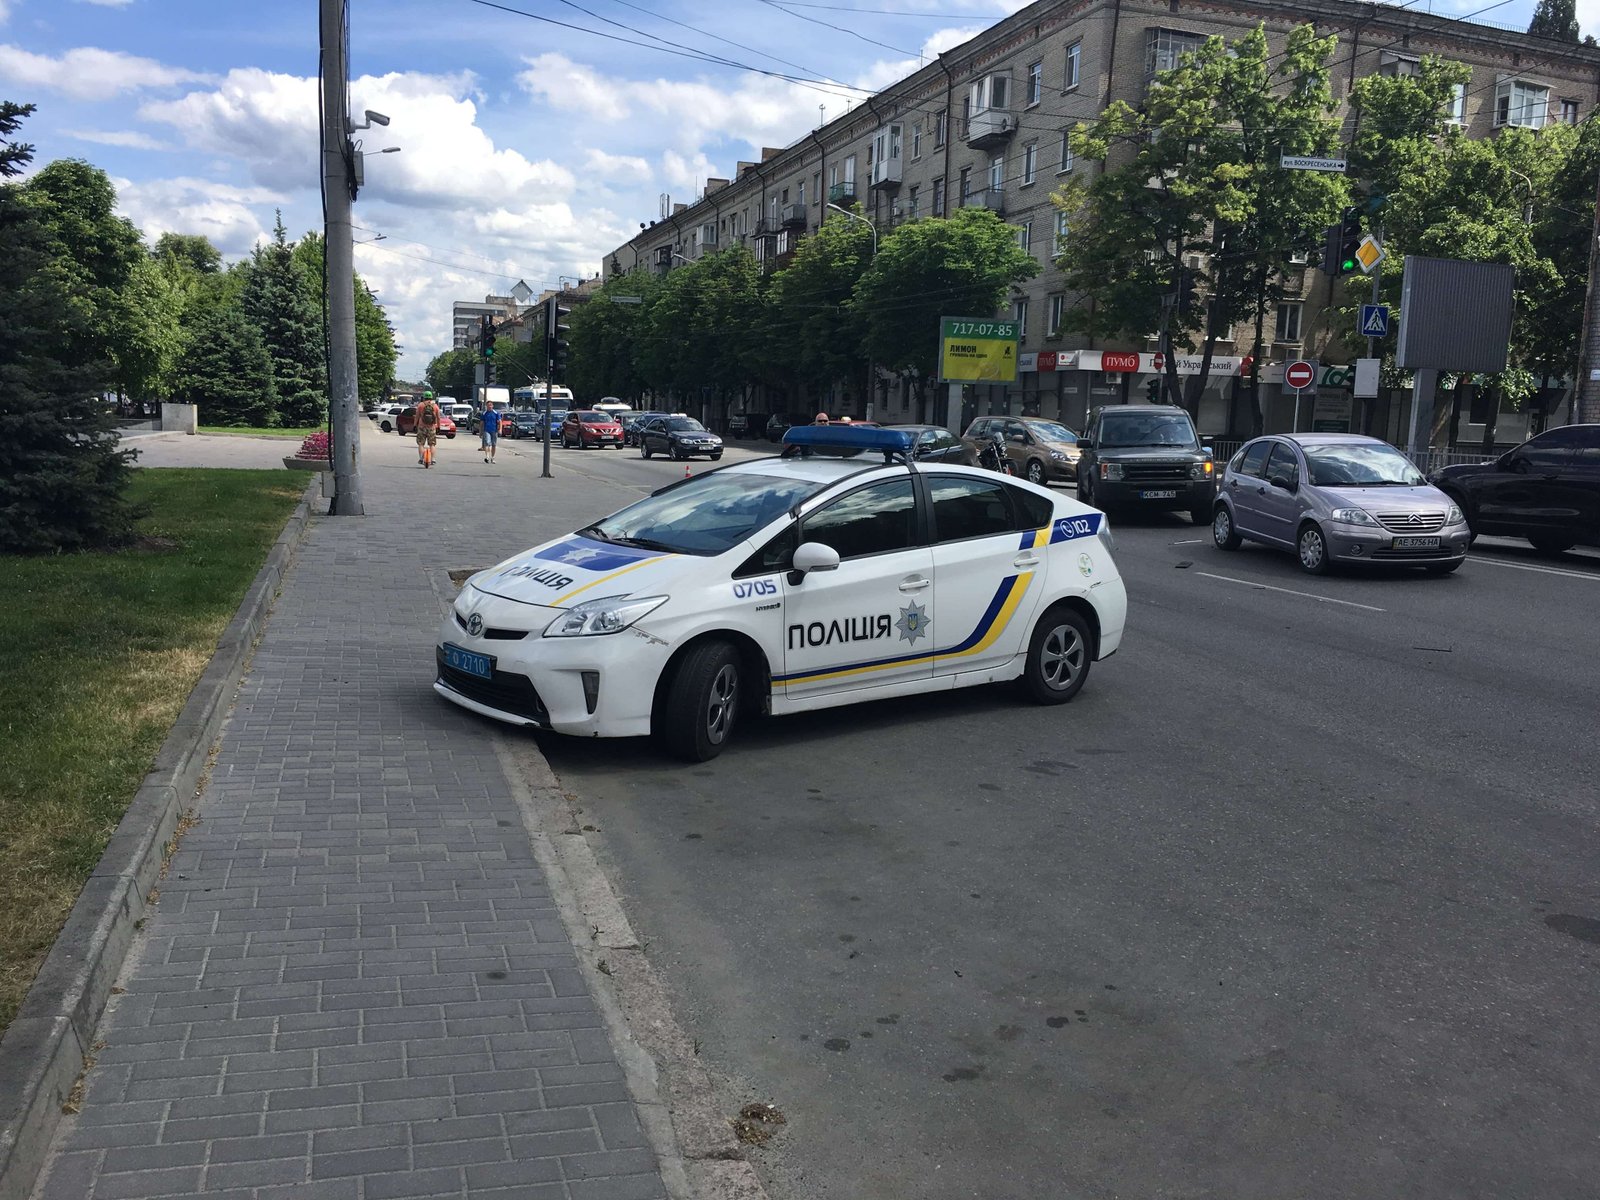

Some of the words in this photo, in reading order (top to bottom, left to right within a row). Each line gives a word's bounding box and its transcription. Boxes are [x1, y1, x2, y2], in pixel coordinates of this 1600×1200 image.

[1294, 160, 1336, 168] ВОСКРЕСЕНСЬКА
[952, 322, 1013, 336] 717-07-85
[950, 344, 976, 353] ЛИМОН
[1183, 360, 1232, 370] Украький
[1071, 519, 1091, 534] 102
[1398, 538, 1408, 546] AE
[733, 579, 777, 598] 0705
[788, 614, 892, 650] ПОЛІЦІЯ
[462, 653, 485, 674] 2710
